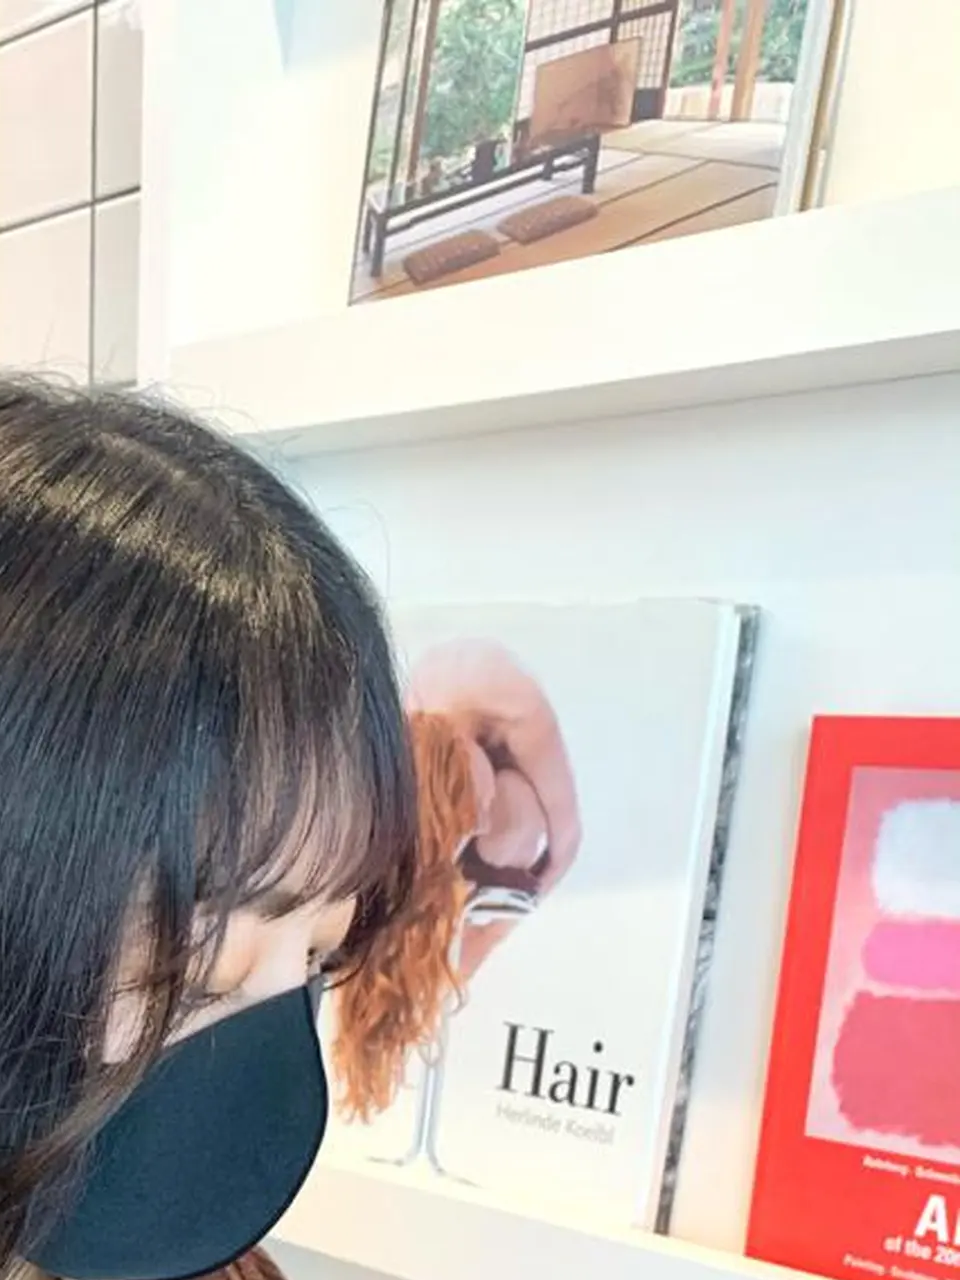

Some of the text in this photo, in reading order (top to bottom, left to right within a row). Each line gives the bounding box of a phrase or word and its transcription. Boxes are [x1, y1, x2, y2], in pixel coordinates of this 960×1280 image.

[495, 1021, 635, 1116] Hair
[883, 1235, 903, 1253] of
[904, 1239, 932, 1261] the
